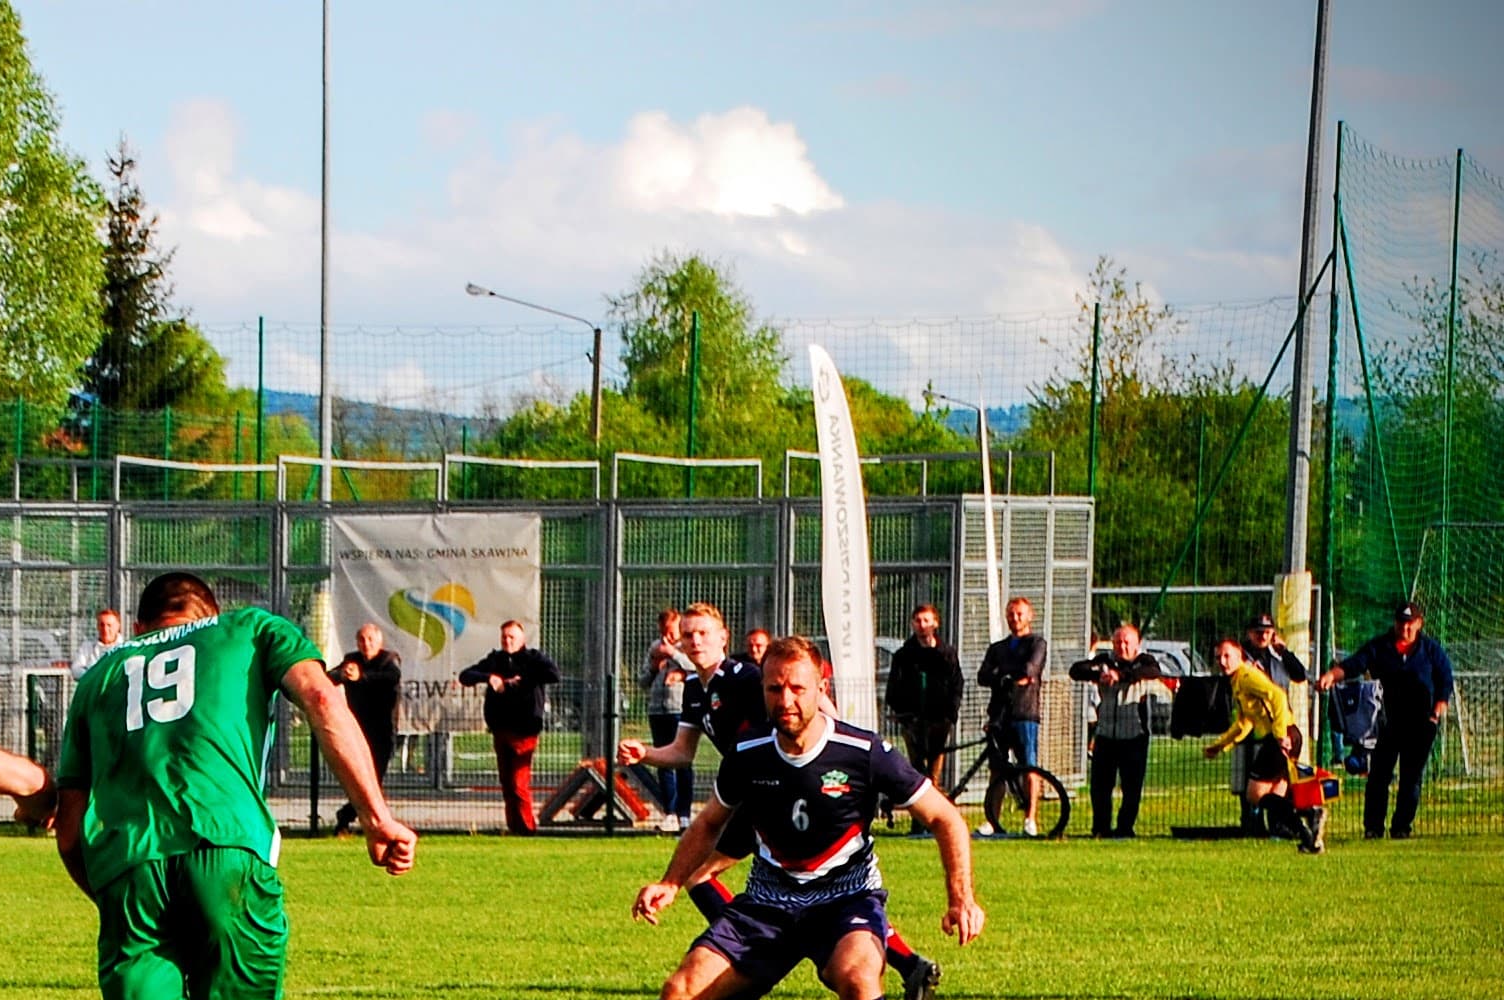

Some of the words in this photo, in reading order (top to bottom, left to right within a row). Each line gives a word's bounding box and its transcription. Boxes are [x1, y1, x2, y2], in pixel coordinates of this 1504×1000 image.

[427, 547, 468, 559] GMINA
[471, 546, 528, 559] SKAWINA
[124, 645, 195, 731] 19
[792, 799, 809, 831] 6
